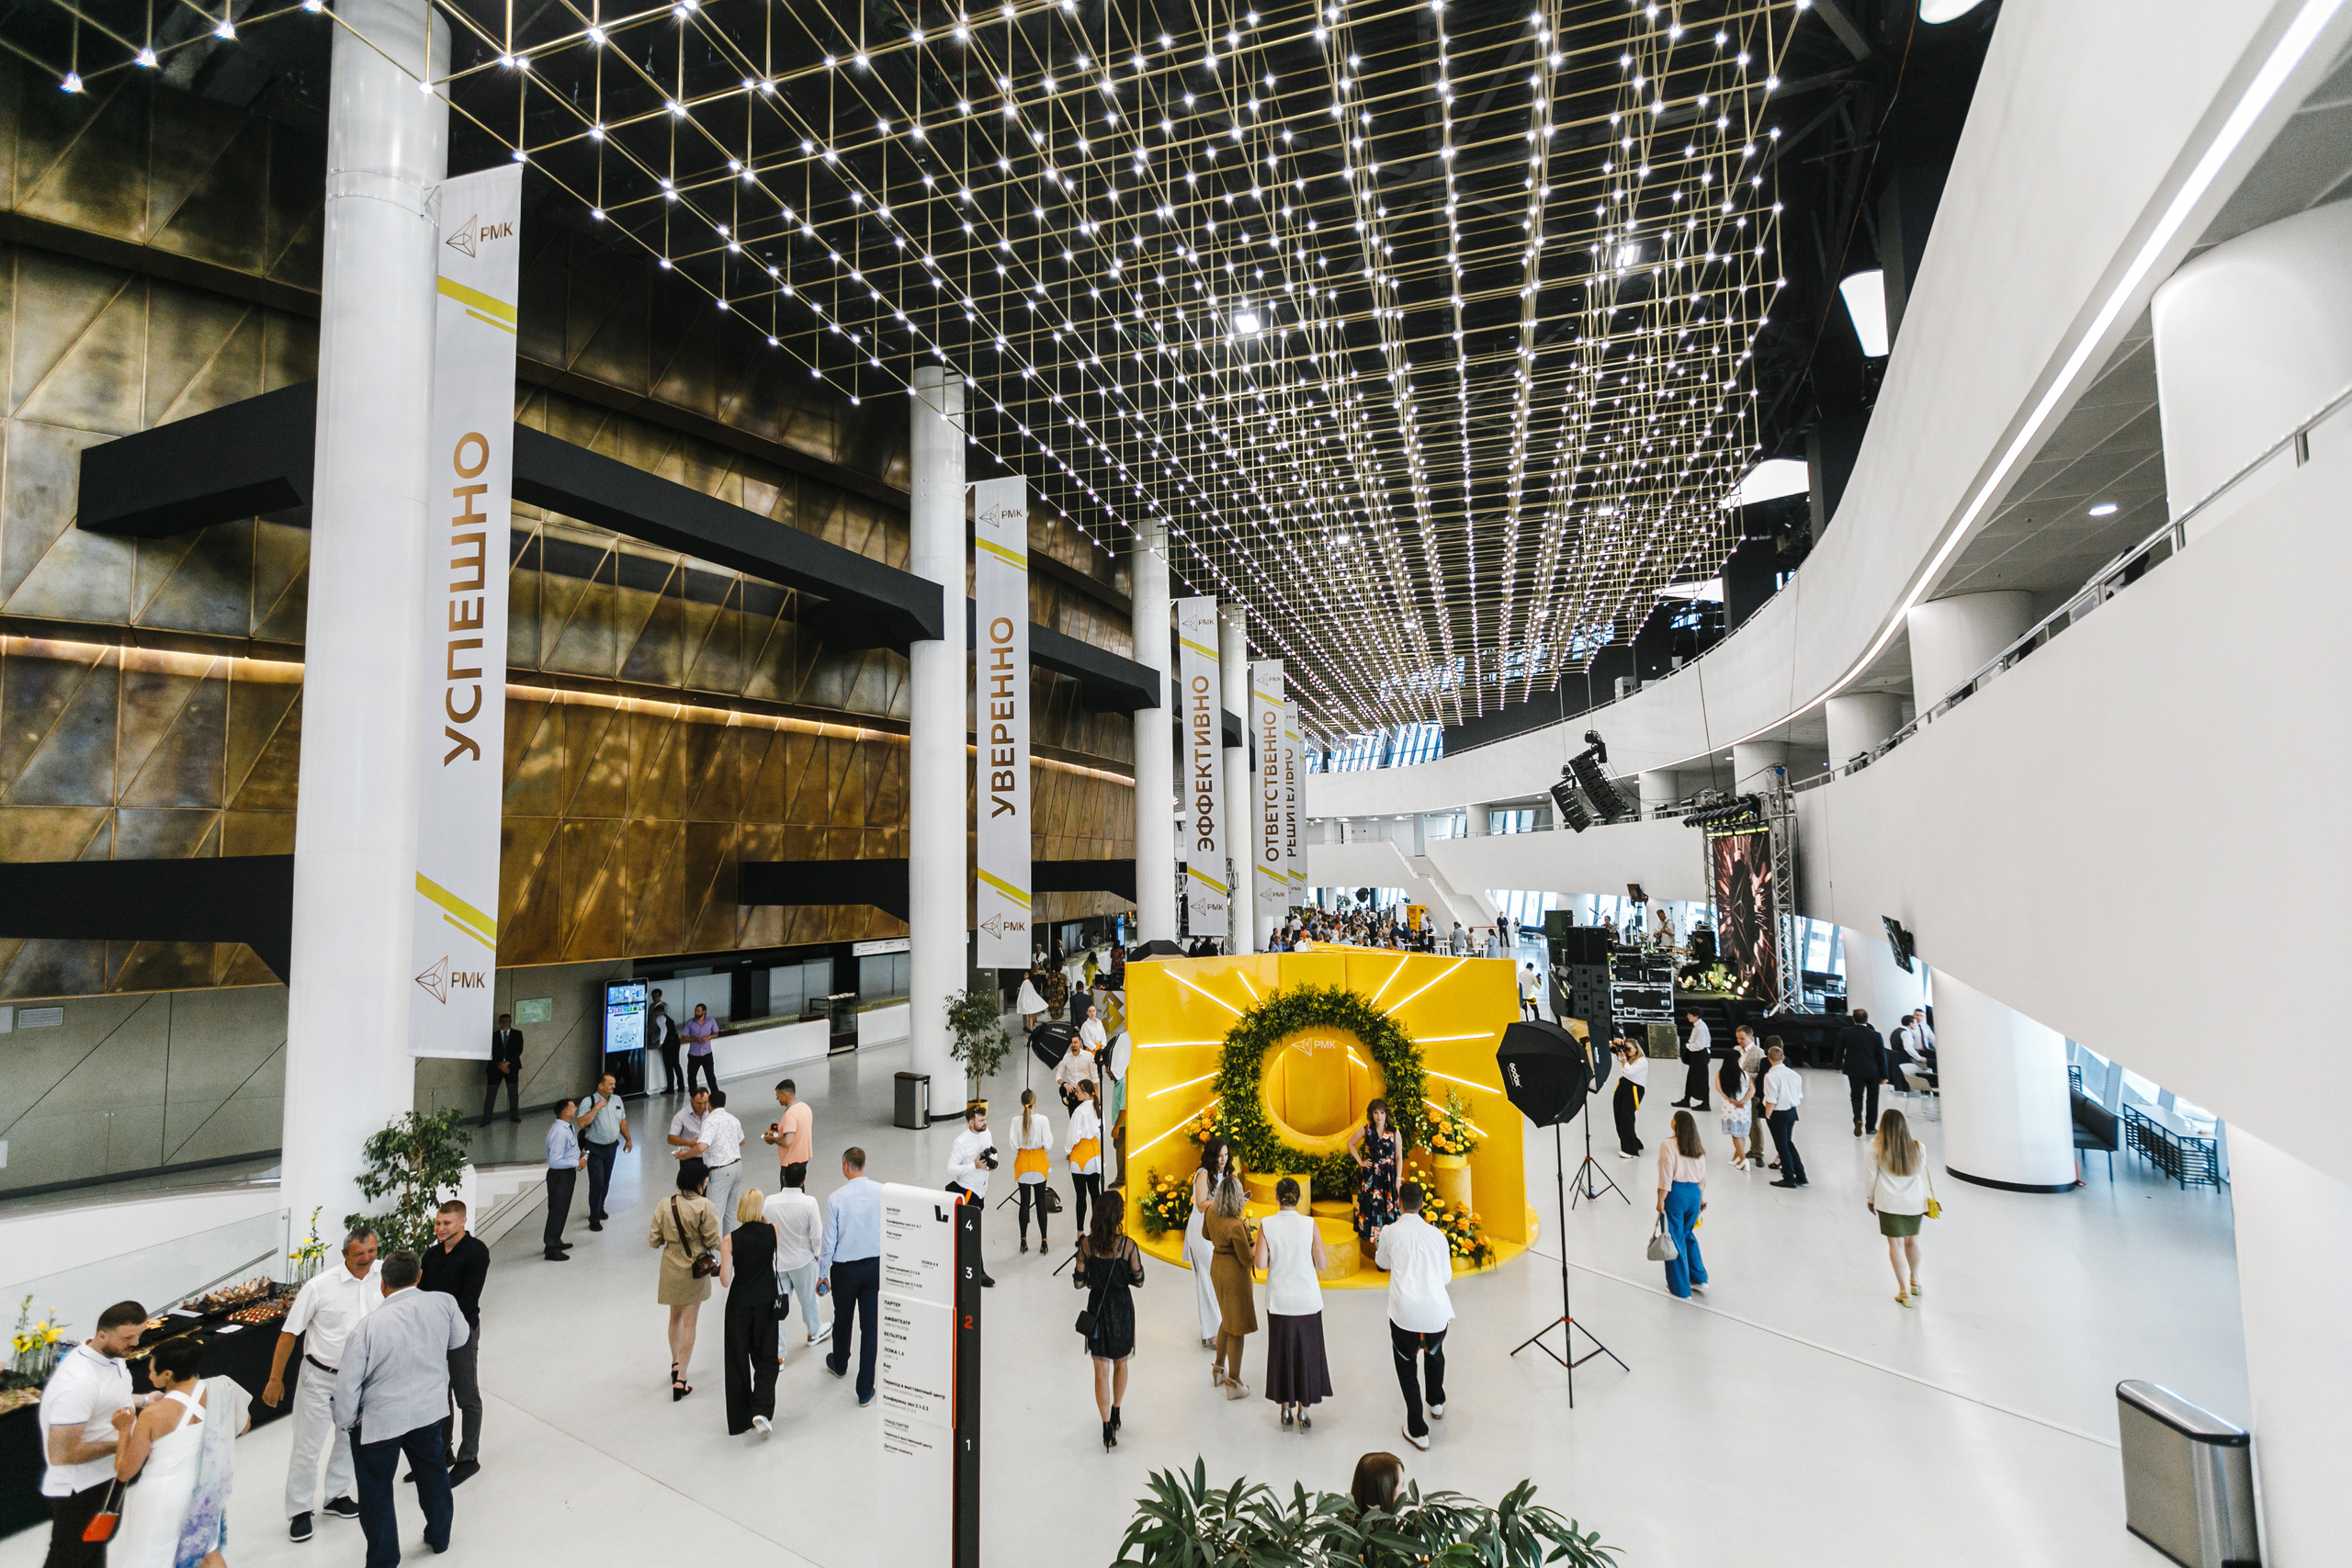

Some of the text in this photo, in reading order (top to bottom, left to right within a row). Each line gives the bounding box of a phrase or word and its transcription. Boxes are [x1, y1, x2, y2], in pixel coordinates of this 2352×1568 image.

[481, 221, 513, 243] РМК
[1001, 509, 1023, 519] РМК
[444, 432, 490, 766] УСПЕШНО
[990, 617, 1015, 818] УВЕРЕННО
[1192, 675, 1215, 852] ЭФФЕКТИВНО
[1263, 711, 1281, 862] ОТВЕТСТВЕННО
[1003, 922, 1025, 931] РМК
[451, 972, 485, 988] РМК
[1314, 1041, 1336, 1049] РМК
[1510, 1062, 1521, 1087] Godox
[966, 1220, 973, 1231] 4
[966, 1267, 972, 1279] 3
[965, 1315, 973, 1329] 2
[966, 1439, 971, 1450] 1
